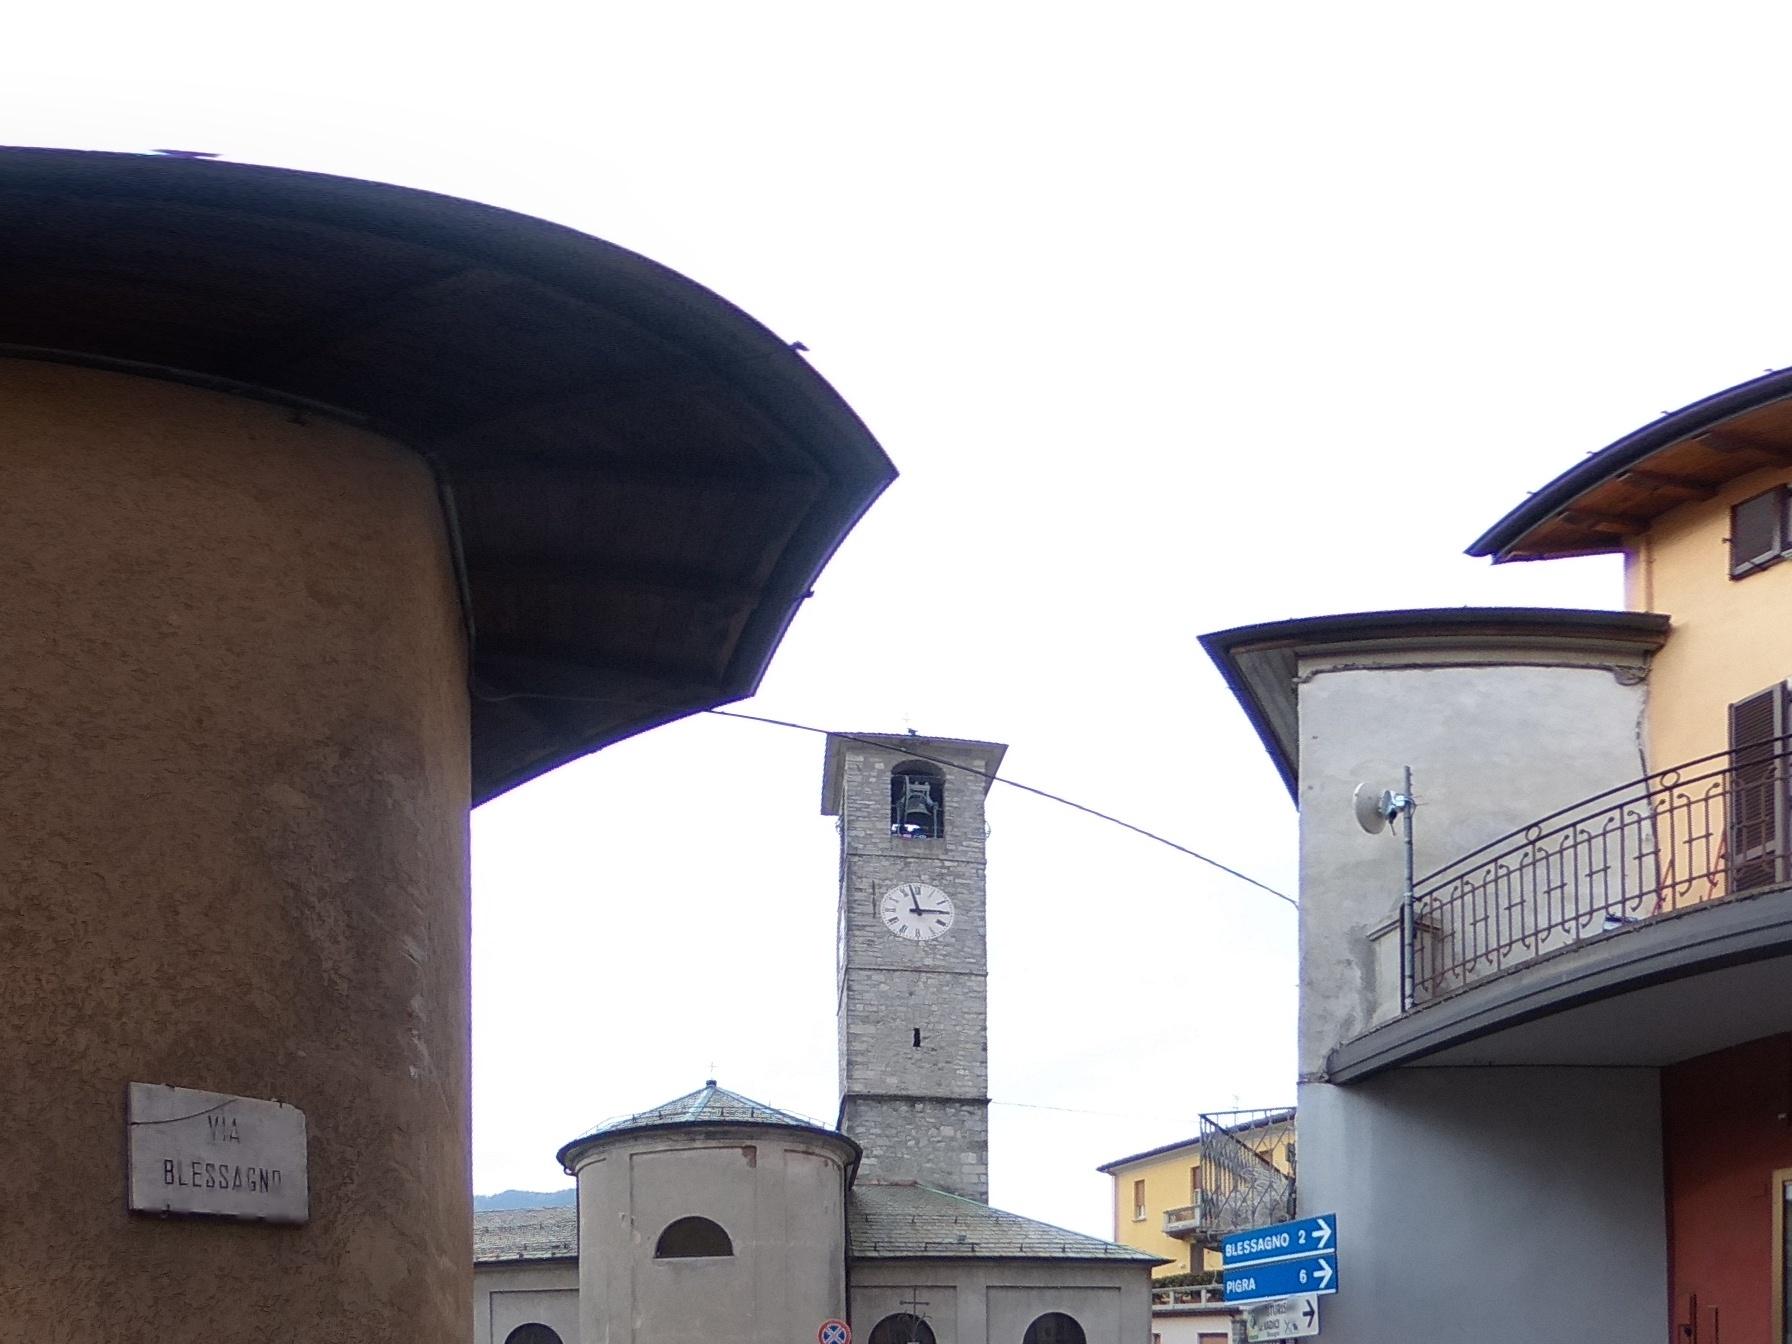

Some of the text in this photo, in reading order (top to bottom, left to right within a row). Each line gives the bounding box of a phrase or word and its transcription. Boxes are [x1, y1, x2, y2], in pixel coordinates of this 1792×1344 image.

[207, 1115, 240, 1143] VIA
[164, 1159, 281, 1192] BLESSAGNO
[1225, 1230, 1306, 1257] BLESSAGNO 2
[1226, 1269, 1307, 1294] PIGRA 6
